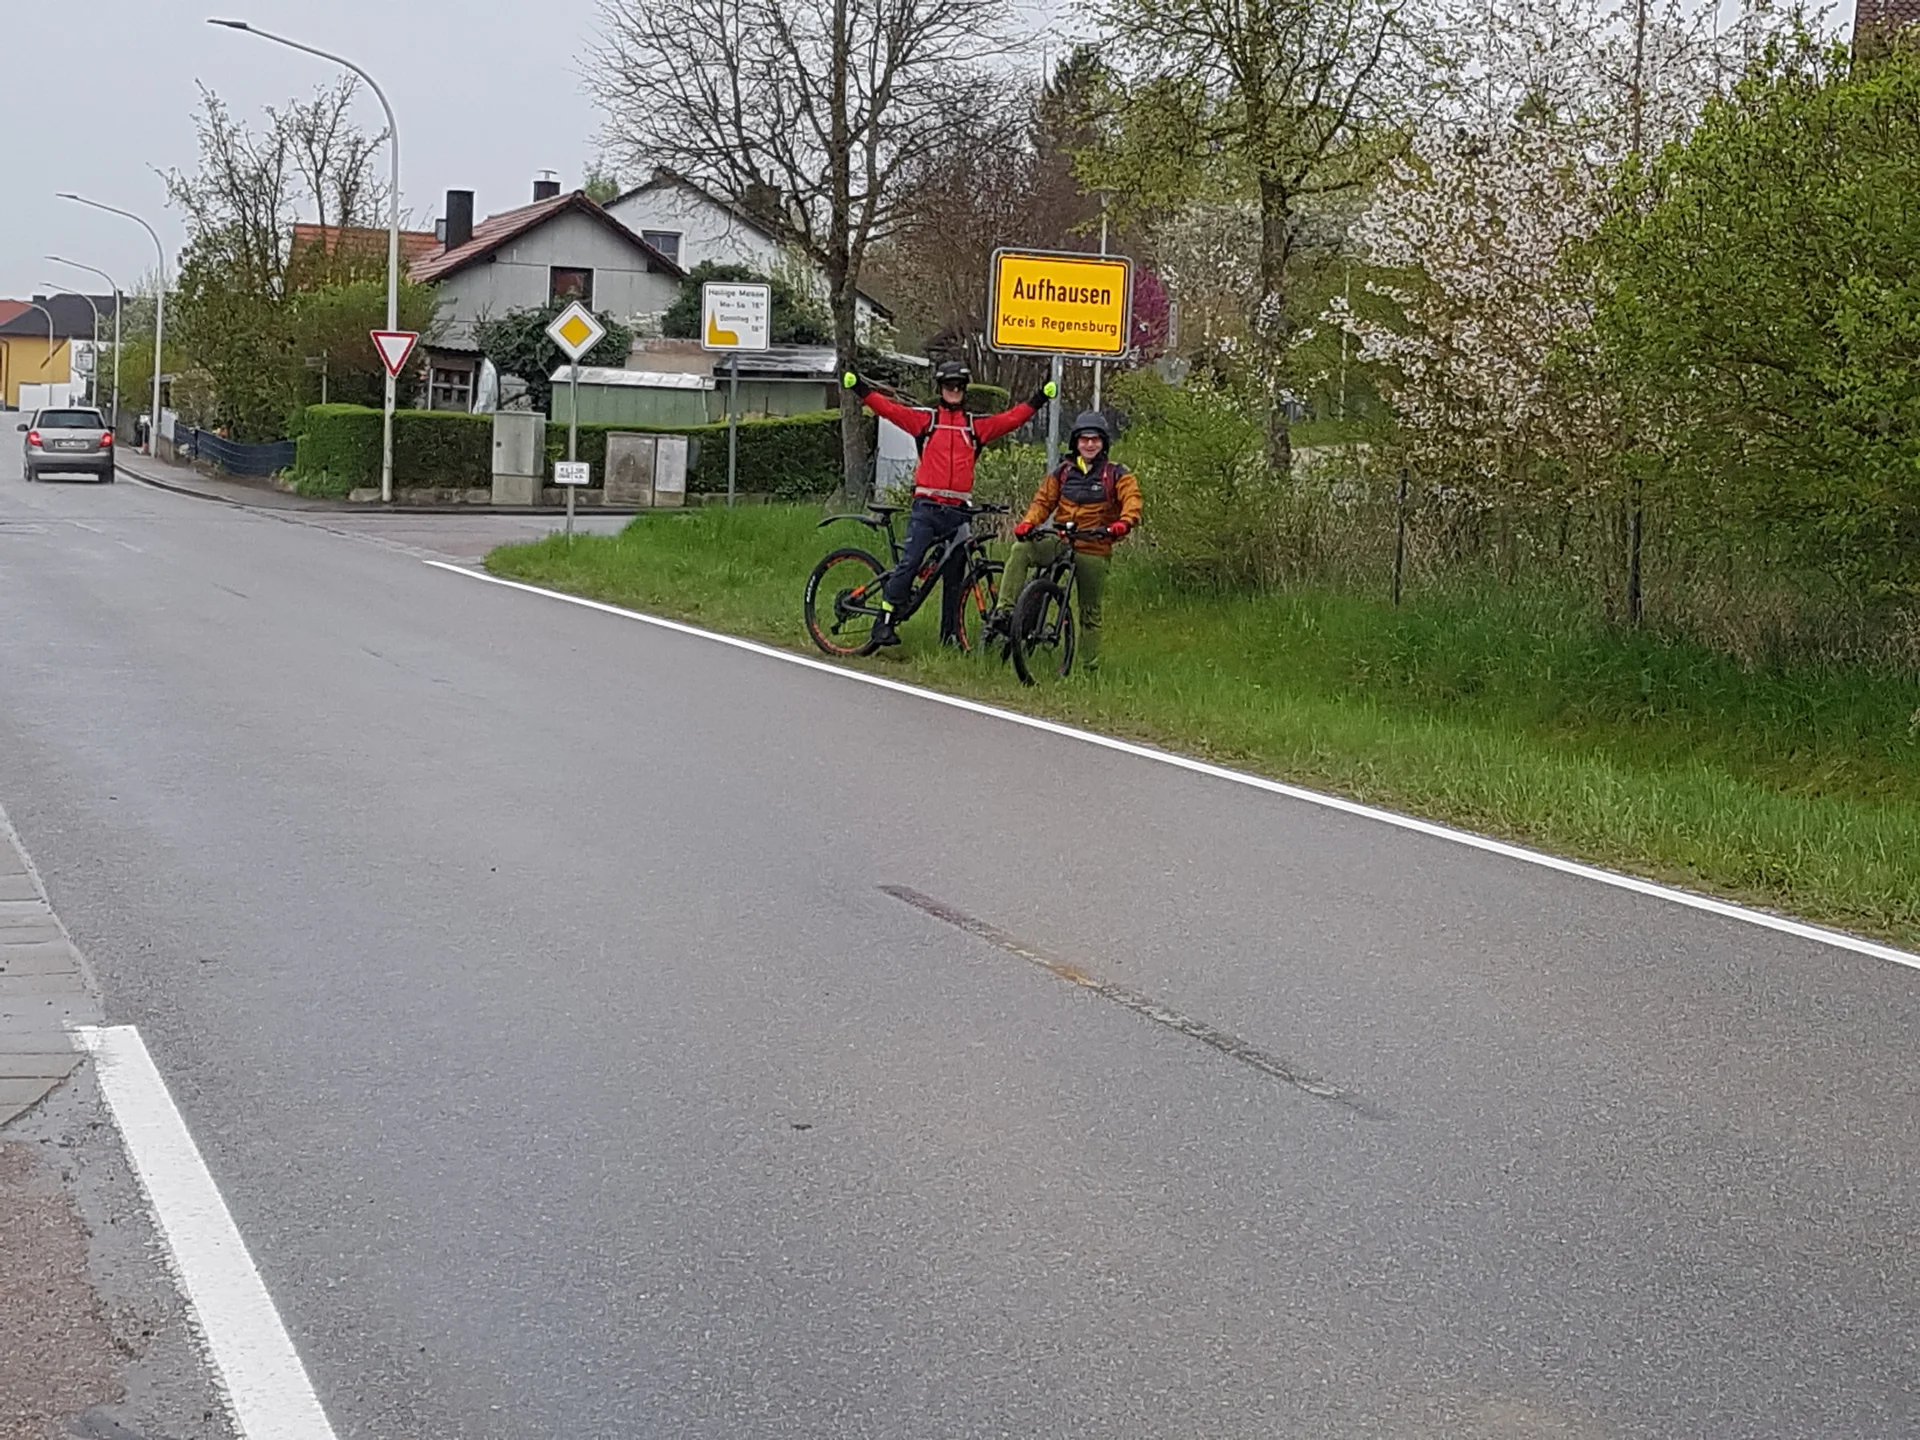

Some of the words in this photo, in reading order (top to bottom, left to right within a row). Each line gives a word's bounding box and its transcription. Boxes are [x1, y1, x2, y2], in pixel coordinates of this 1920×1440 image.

[1012, 276, 1111, 305] Aufhausen
[1002, 313, 1036, 328] Kreis
[1041, 316, 1118, 337] Regensburg
